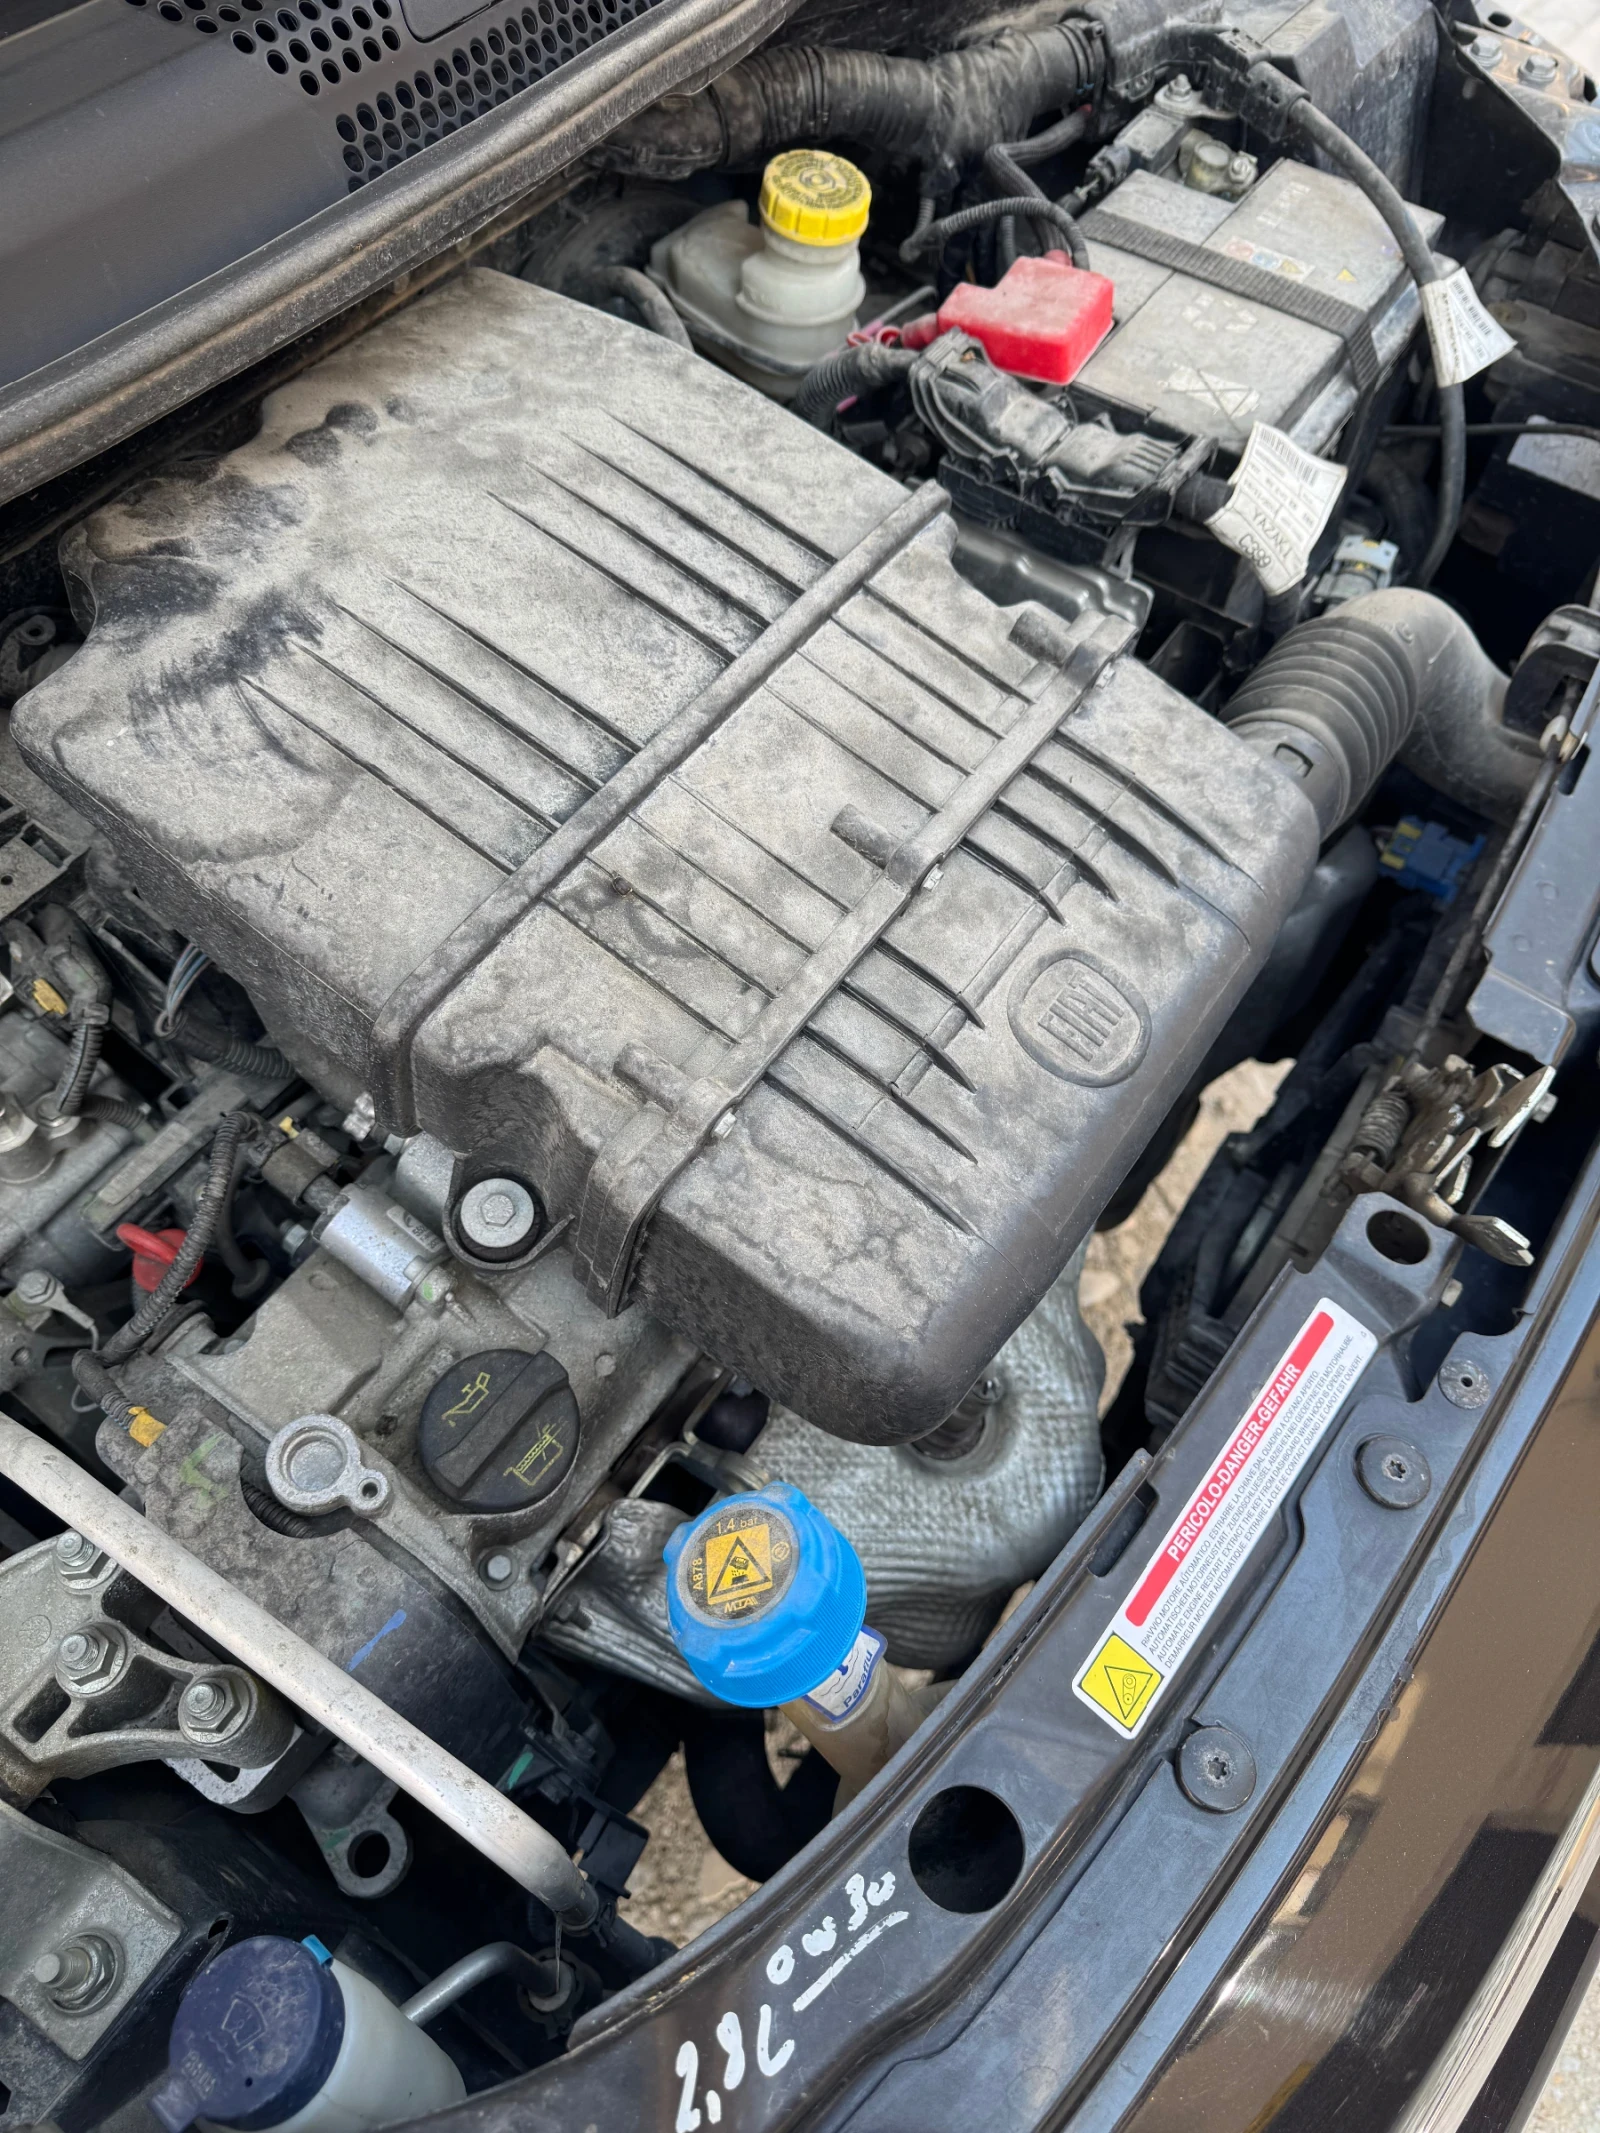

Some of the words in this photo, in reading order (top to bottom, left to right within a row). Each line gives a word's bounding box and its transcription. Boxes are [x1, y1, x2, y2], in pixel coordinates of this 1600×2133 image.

[1252, 510, 1293, 558] YAZAKI
[1037, 970, 1124, 1062] FIAT
[716, 1518, 736, 1535] 1.4
[740, 1517, 758, 1530] bar
[1140, 1615, 1163, 1647] RIAVVIO
[1158, 1584, 1183, 1618] MOTORE
[1208, 1501, 1235, 1540] ESTRARRE
[1231, 1492, 1241, 1504] LA
[1237, 1468, 1256, 1494] CHIAVE
[1252, 1454, 1265, 1470] DAL
[1261, 1426, 1283, 1456] QUADRO
[1282, 1394, 1303, 1423] COFANO
[1147, 1591, 1190, 1655] AUTOMATISCHER
[1226, 1464, 1271, 1531] ZUENDSCHLUESSEL
[1266, 1432, 1291, 1466] ABZIEHEN
[1286, 1420, 1298, 1434] BEI
[1294, 1375, 1327, 1423] GEOEFFNETER
[1155, 1617, 1187, 1662] AUTOMATIC
[1182, 1590, 1204, 1619] ENGINE
[1221, 1523, 1245, 1557] EXTRACT
[1241, 1509, 1254, 1525] THE
[1250, 1494, 1263, 1511] KEY
[1259, 1475, 1275, 1497] FROM
[1271, 1435, 1301, 1477] DASHBOARD
[1296, 1415, 1313, 1437] WHEN
[1309, 1396, 1325, 1417] HOOD
[1321, 1389, 1329, 1398] IS
[1164, 1621, 1197, 1669] DEMARREUR
[1192, 1589, 1216, 1623] MOTEUR
[1243, 1506, 1268, 1541] EXTRAIRE
[1263, 1497, 1274, 1508] LA
[1269, 1483, 1282, 1499] CLE
[1278, 1474, 1288, 1486] DE
[1284, 1443, 1307, 1476] CONTACT
[1303, 1421, 1321, 1446] QUAND
[1317, 1412, 1326, 1423] LE
[1322, 1391, 1339, 1414] CAPOT
[1335, 1379, 1347, 1393] EST
[1166, 1361, 1301, 1562] PERICOLO-DANGER-GEFAHR
[692, 1557, 704, 1591] A878
